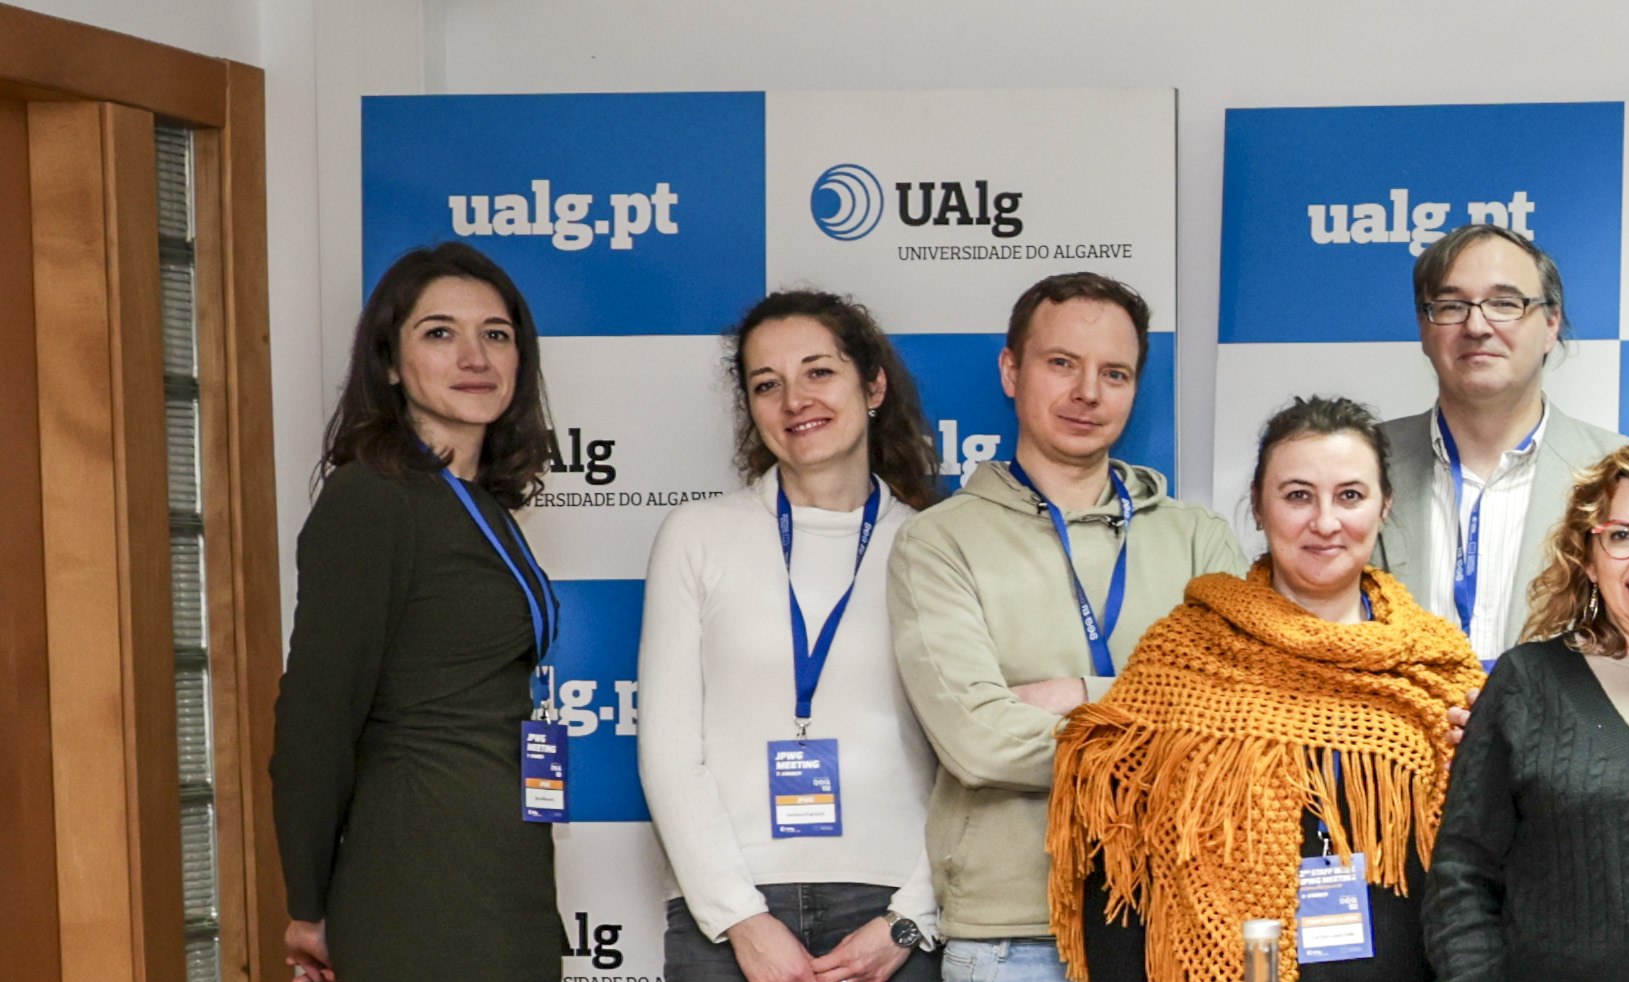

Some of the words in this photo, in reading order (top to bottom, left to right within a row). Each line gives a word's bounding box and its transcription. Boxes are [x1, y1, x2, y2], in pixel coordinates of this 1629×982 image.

[448, 180, 679, 251] ualg.pt
[896, 181, 1024, 238] UAlg
[1308, 189, 1535, 257] ualgt
[898, 245, 1022, 260] UNIVERSIDADE
[1026, 245, 1049, 260] DO
[1053, 244, 1132, 259] ALGARVE
[547, 427, 617, 485] Alg
[525, 492, 615, 507] VERSIDADE
[618, 492, 642, 506] DO
